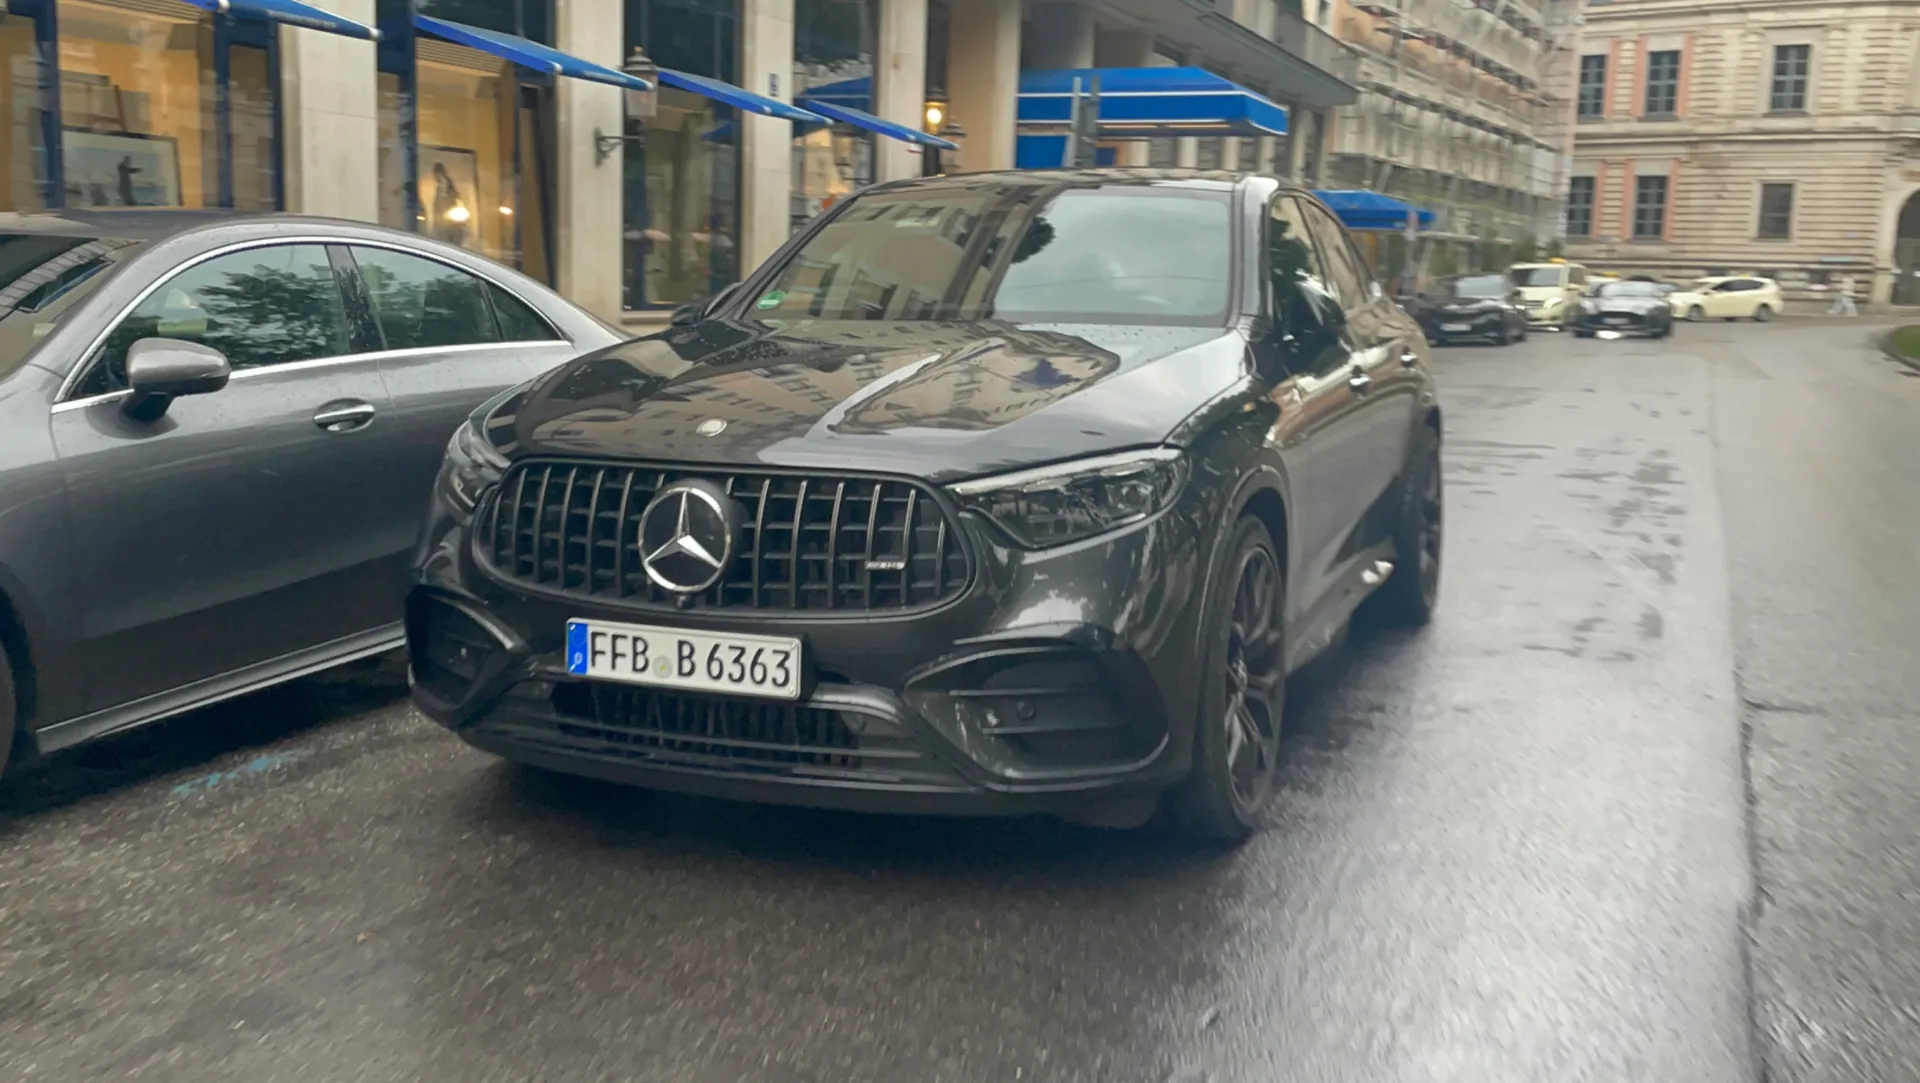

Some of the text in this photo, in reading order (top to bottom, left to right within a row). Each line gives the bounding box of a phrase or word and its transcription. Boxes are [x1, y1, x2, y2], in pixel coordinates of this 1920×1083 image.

[590, 631, 791, 687] FFB B 6363
